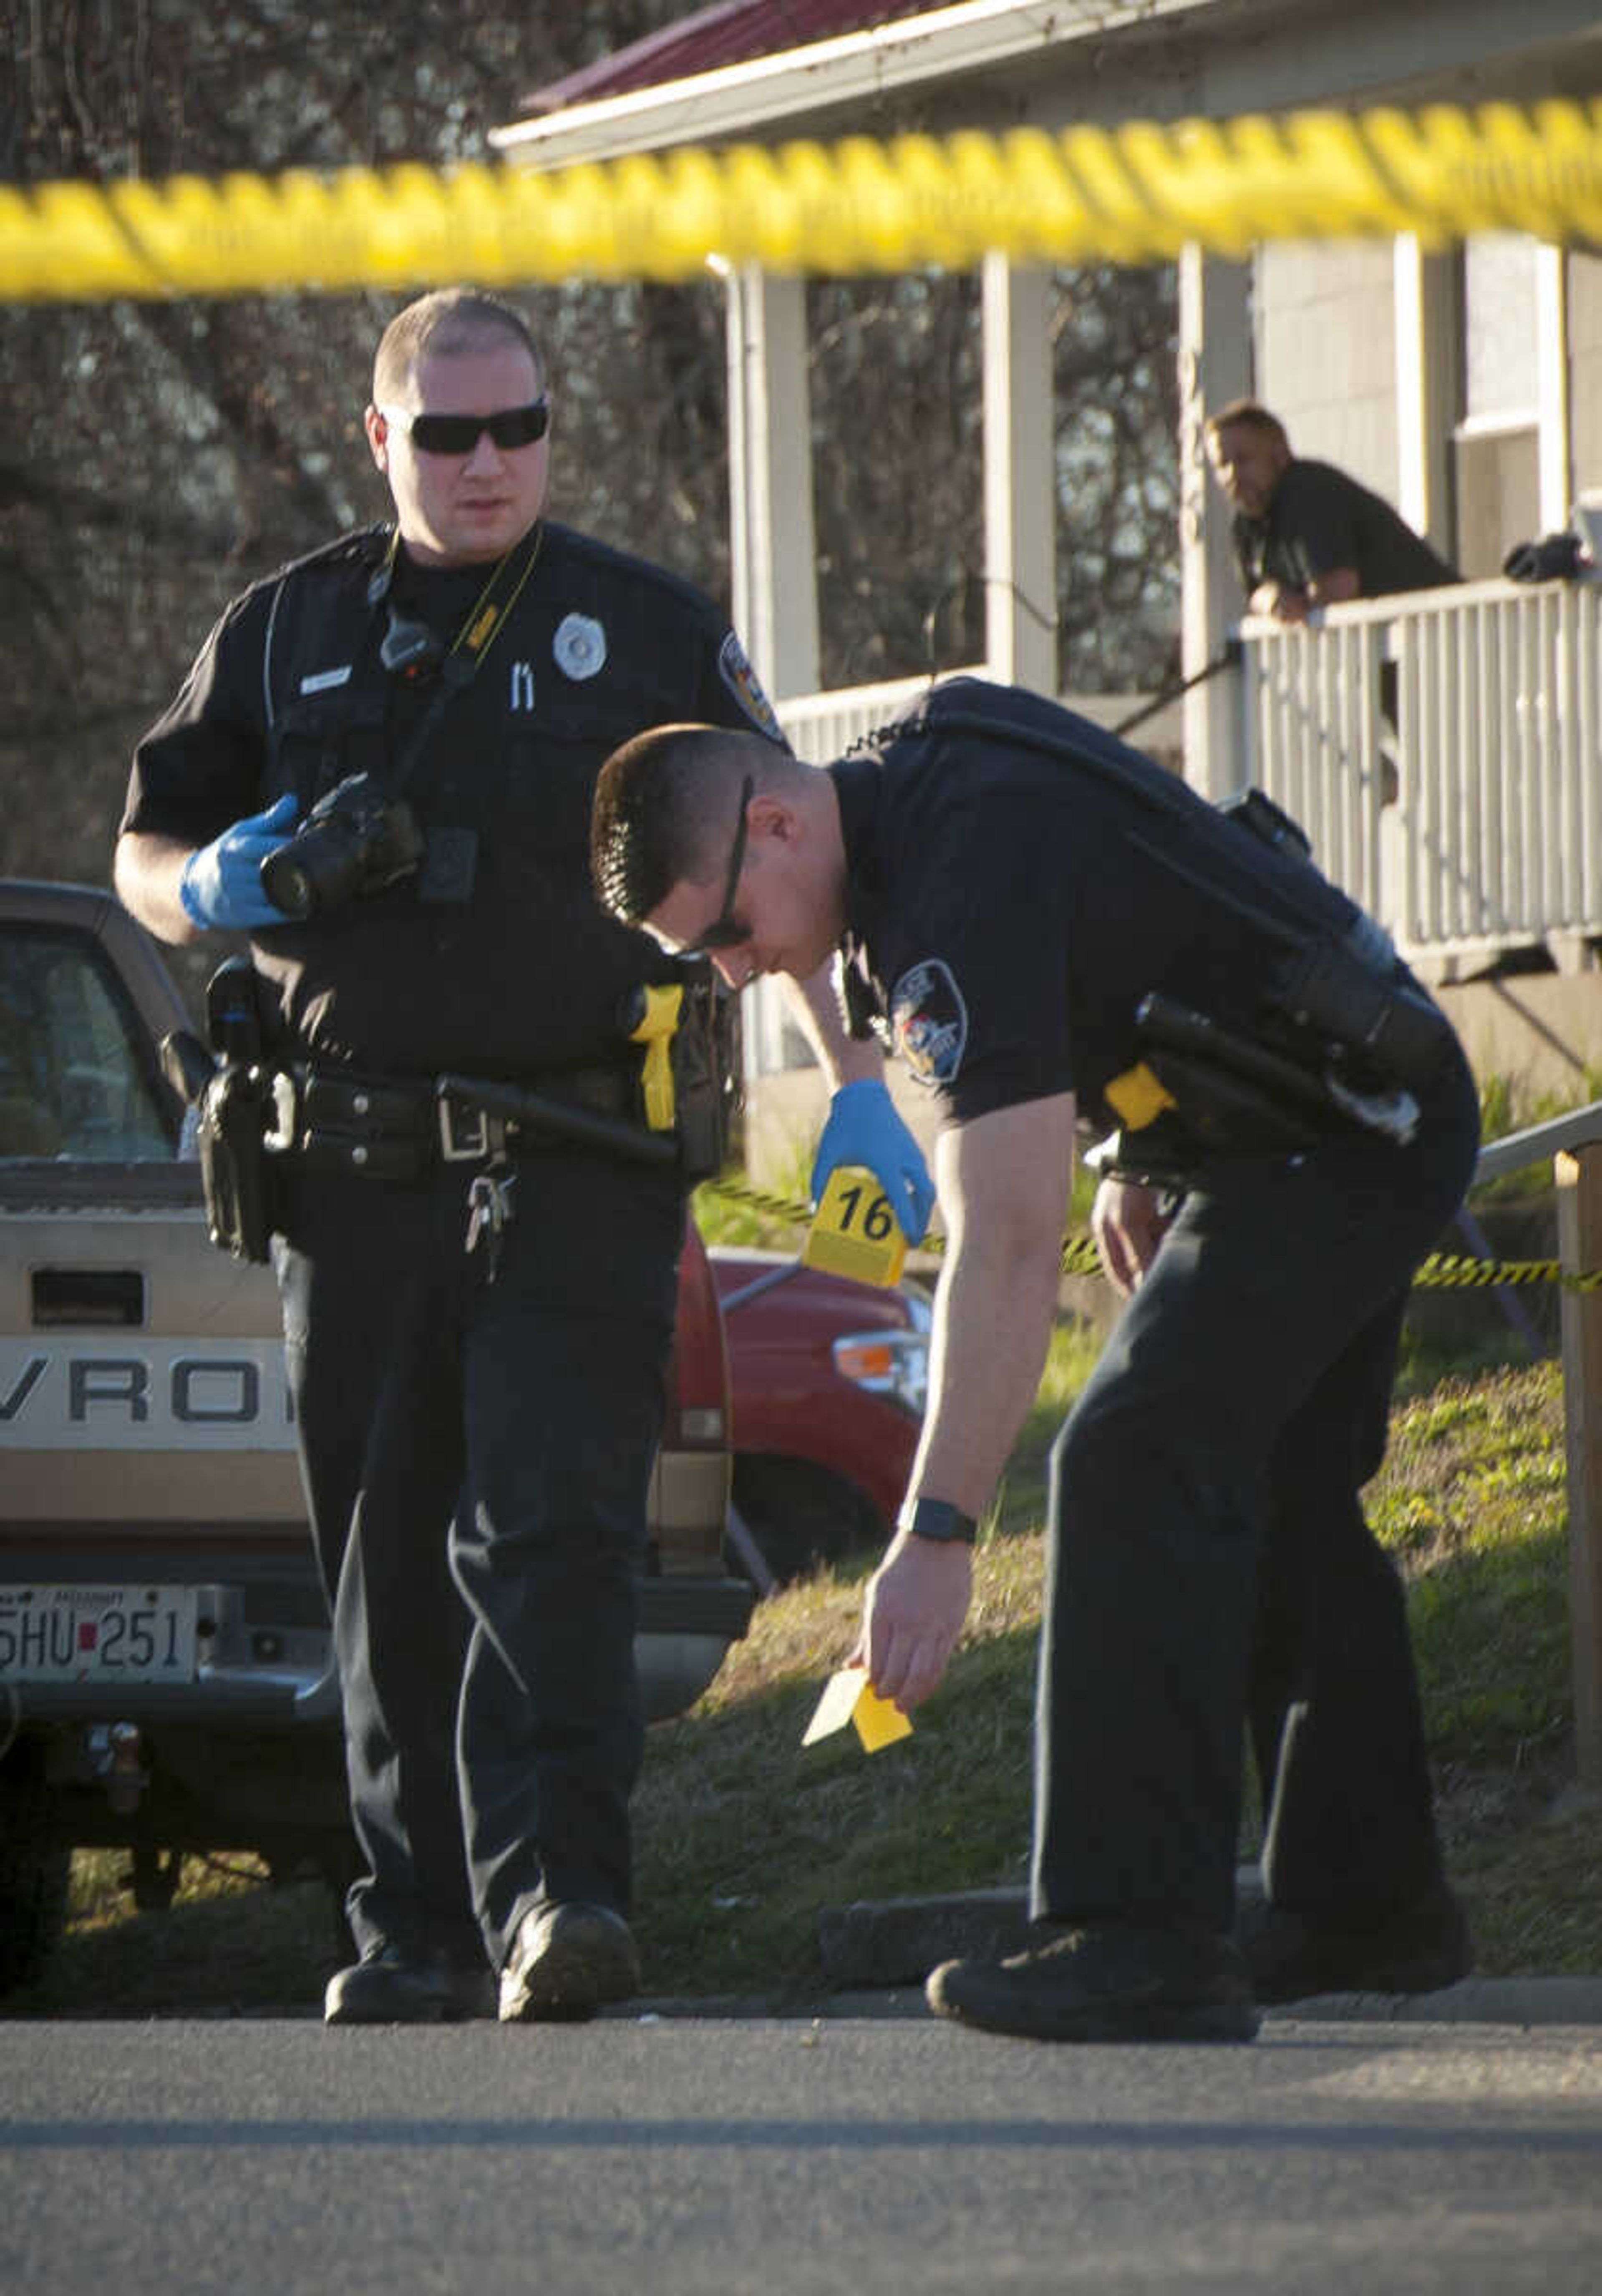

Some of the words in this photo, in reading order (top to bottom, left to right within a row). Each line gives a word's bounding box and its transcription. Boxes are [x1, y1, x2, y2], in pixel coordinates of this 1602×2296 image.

[840, 1187, 892, 1241] 16
[0, 1360, 296, 1422] VRO
[100, 1609, 179, 1667] 251
